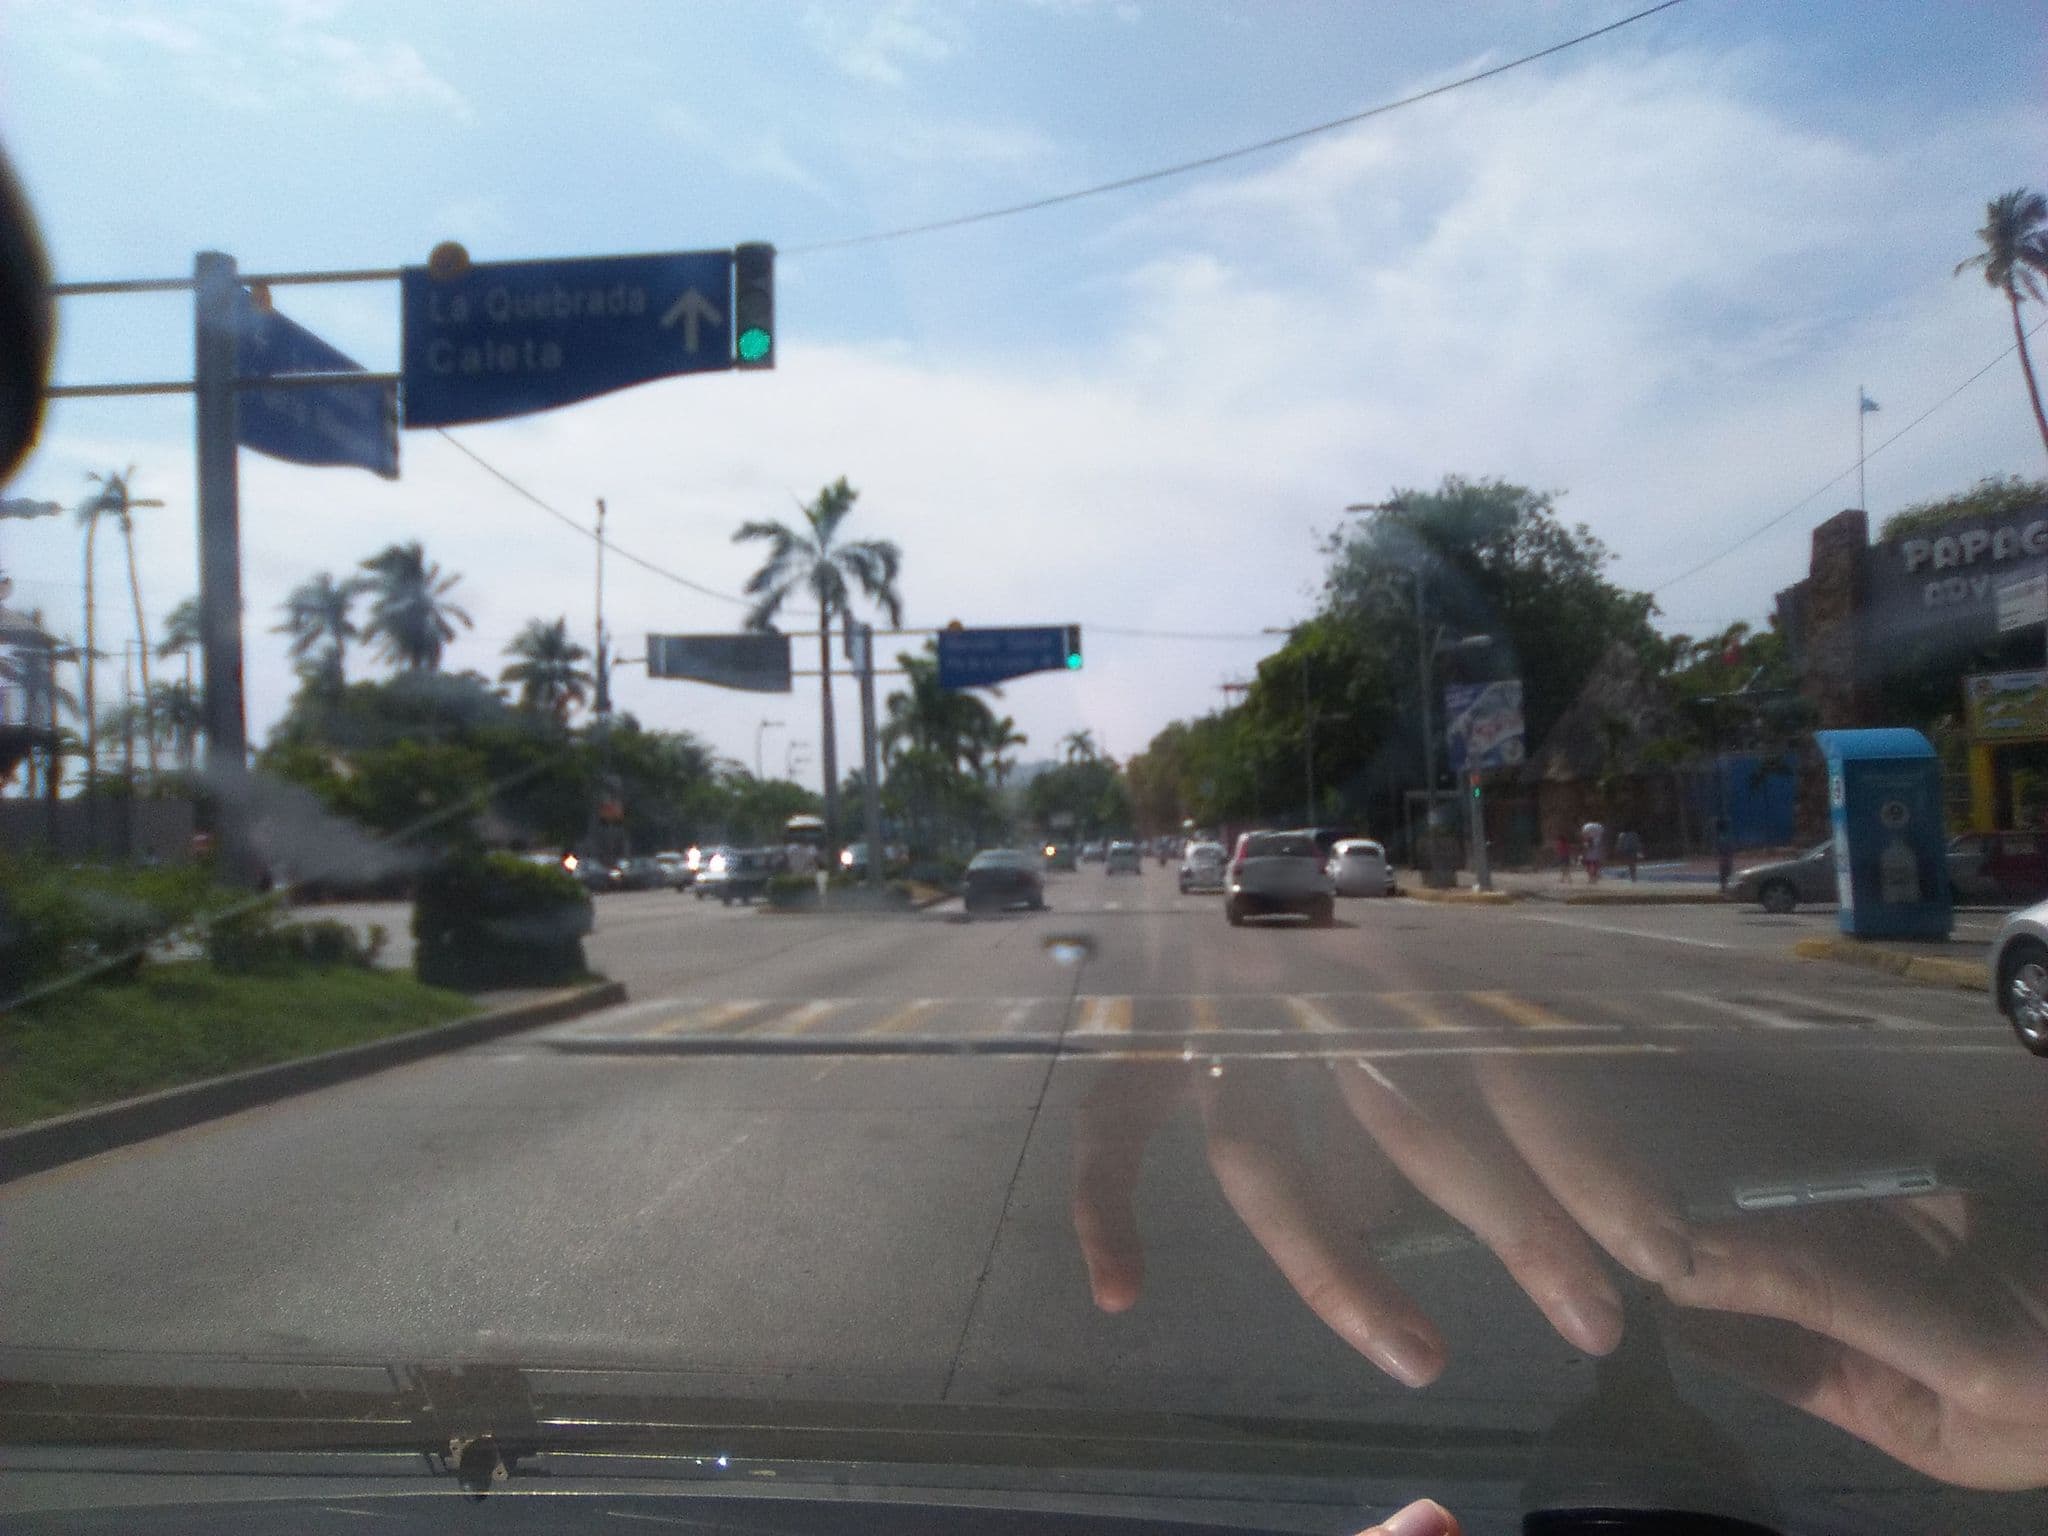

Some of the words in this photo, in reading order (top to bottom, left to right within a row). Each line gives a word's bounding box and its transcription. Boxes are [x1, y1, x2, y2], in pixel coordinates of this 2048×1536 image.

[429, 290, 469, 323] La
[486, 283, 647, 322] Quebrada
[429, 338, 562, 374] Caleta
